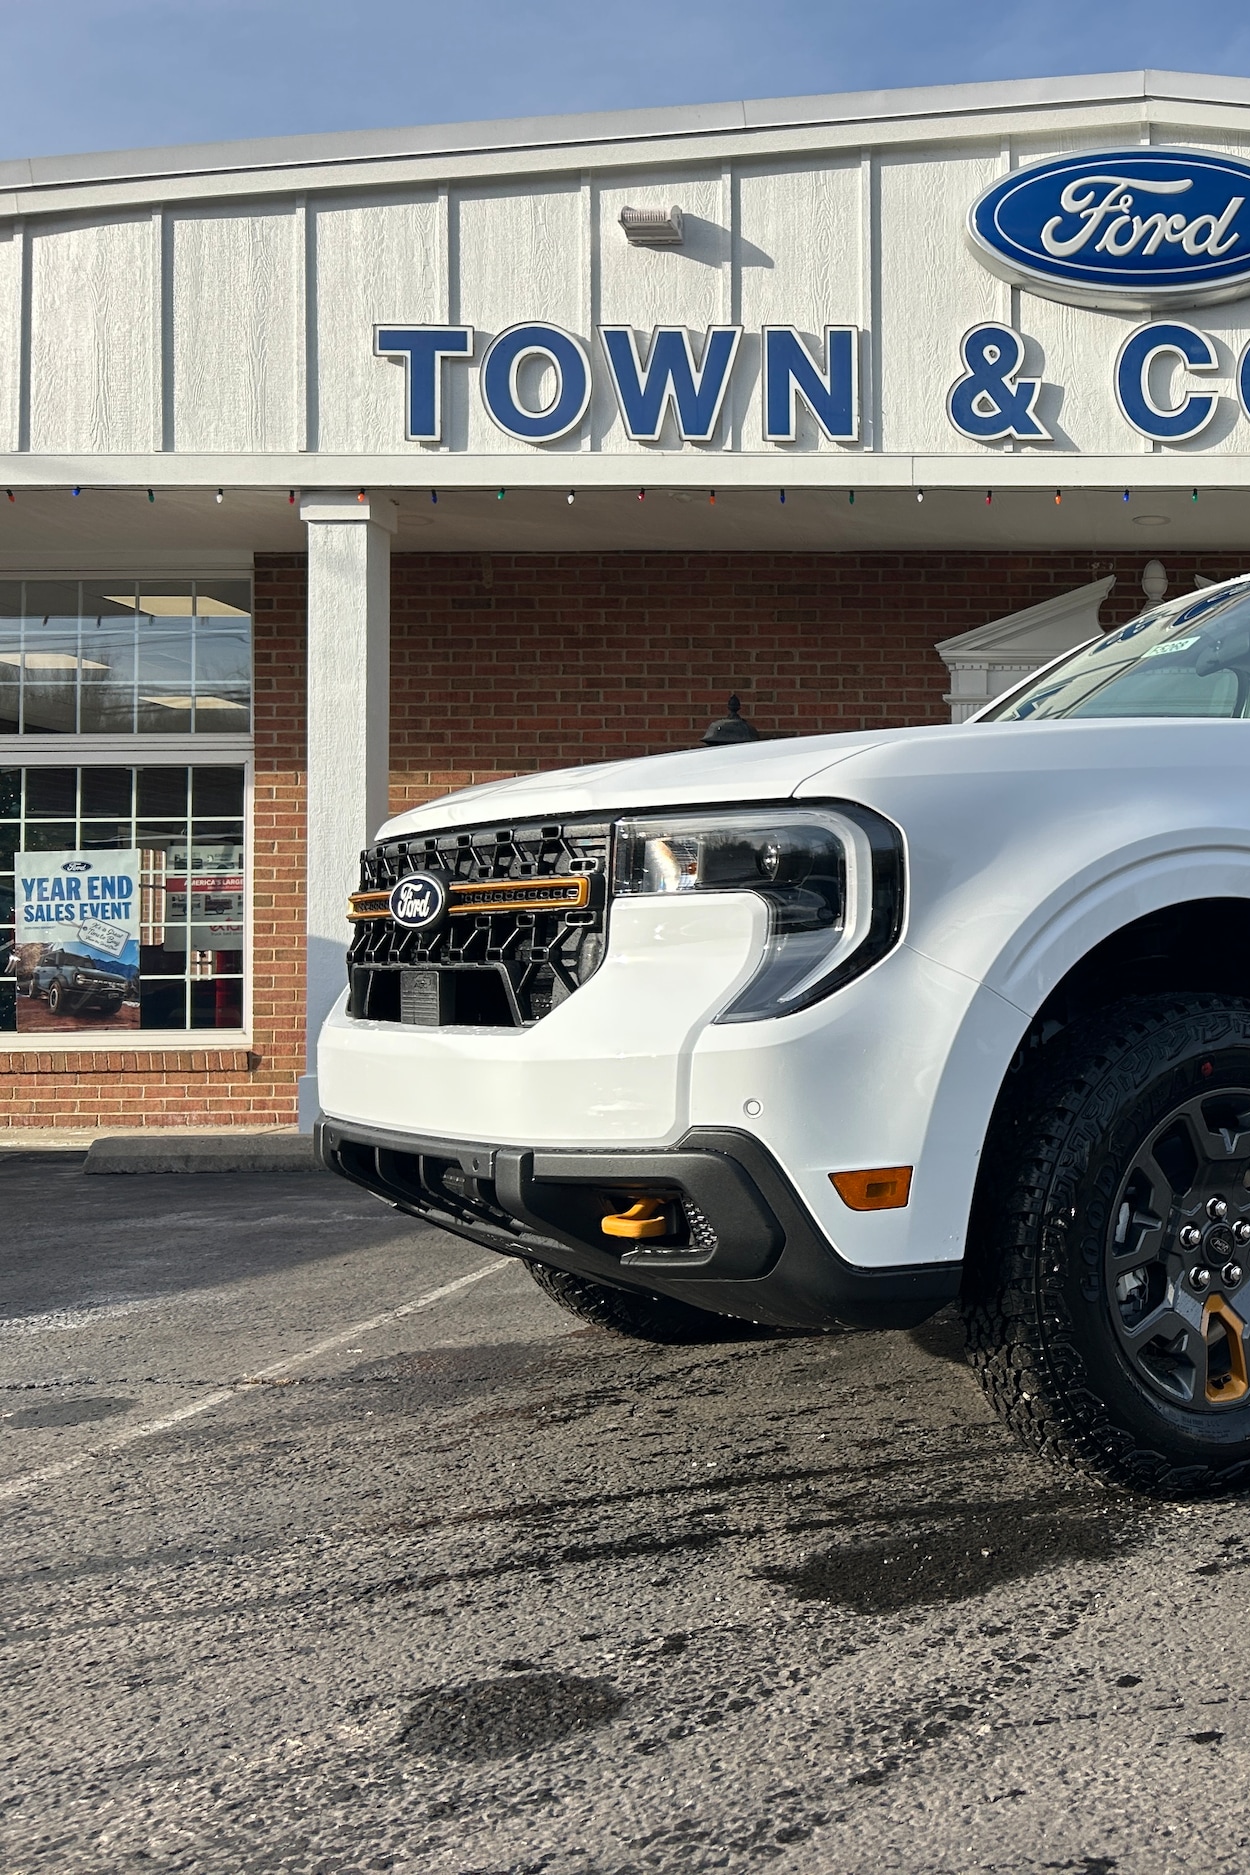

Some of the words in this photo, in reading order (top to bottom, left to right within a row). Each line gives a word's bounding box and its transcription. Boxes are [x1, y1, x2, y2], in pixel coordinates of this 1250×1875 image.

[1040, 175, 1245, 257] Ford
[372, 320, 860, 443] TOWN
[946, 321, 1055, 441] &
[21, 876, 82, 902] YEAR
[87, 875, 133, 900] END
[398, 883, 430, 918] Ford
[23, 903, 75, 922] SALES
[79, 901, 132, 921] EVENT
